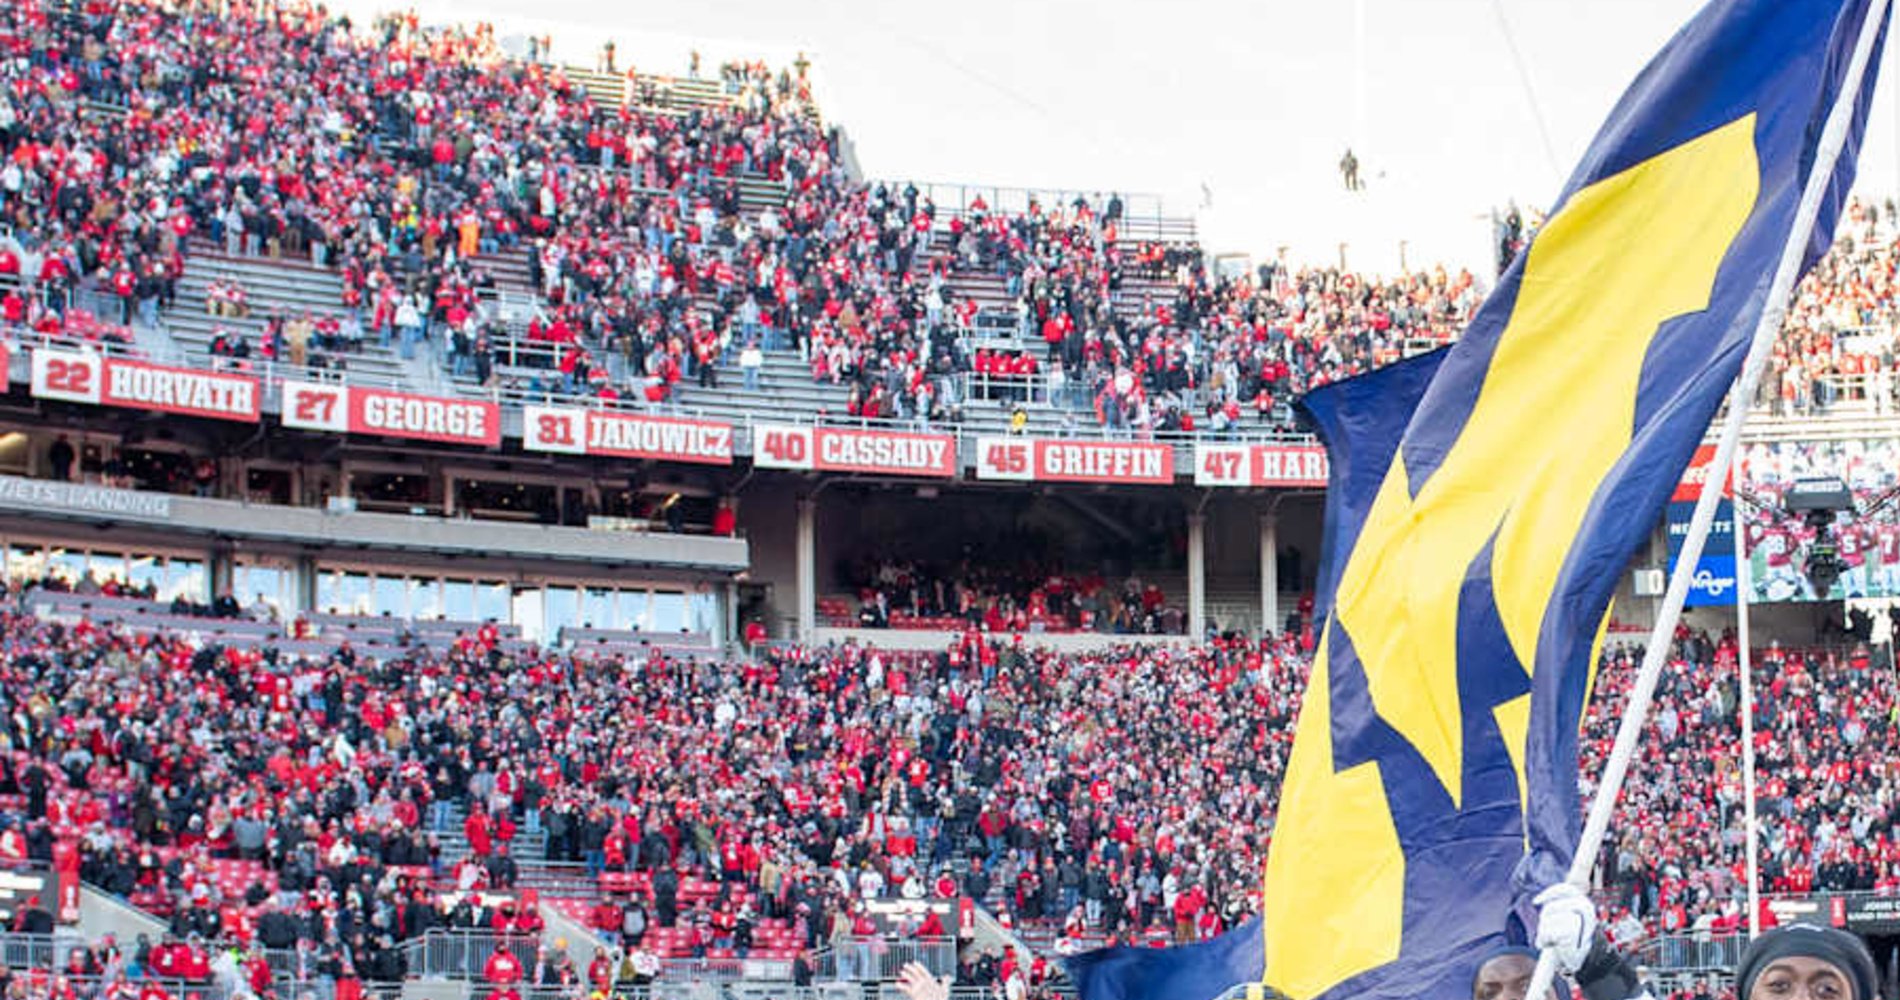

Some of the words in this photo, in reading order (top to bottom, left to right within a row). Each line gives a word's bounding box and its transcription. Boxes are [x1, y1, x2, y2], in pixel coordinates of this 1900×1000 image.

[46, 359, 91, 394] 22
[109, 364, 253, 416] HORVATH
[297, 391, 338, 422] 27
[364, 396, 484, 438] GEORGE
[537, 414, 575, 446] 31
[588, 414, 731, 458] JANOWICZ
[764, 431, 806, 462] 40
[820, 436, 946, 471] CASSADY
[986, 444, 1027, 474] 45
[1044, 446, 1164, 478] GRIFFIN
[1204, 451, 1238, 481] 47
